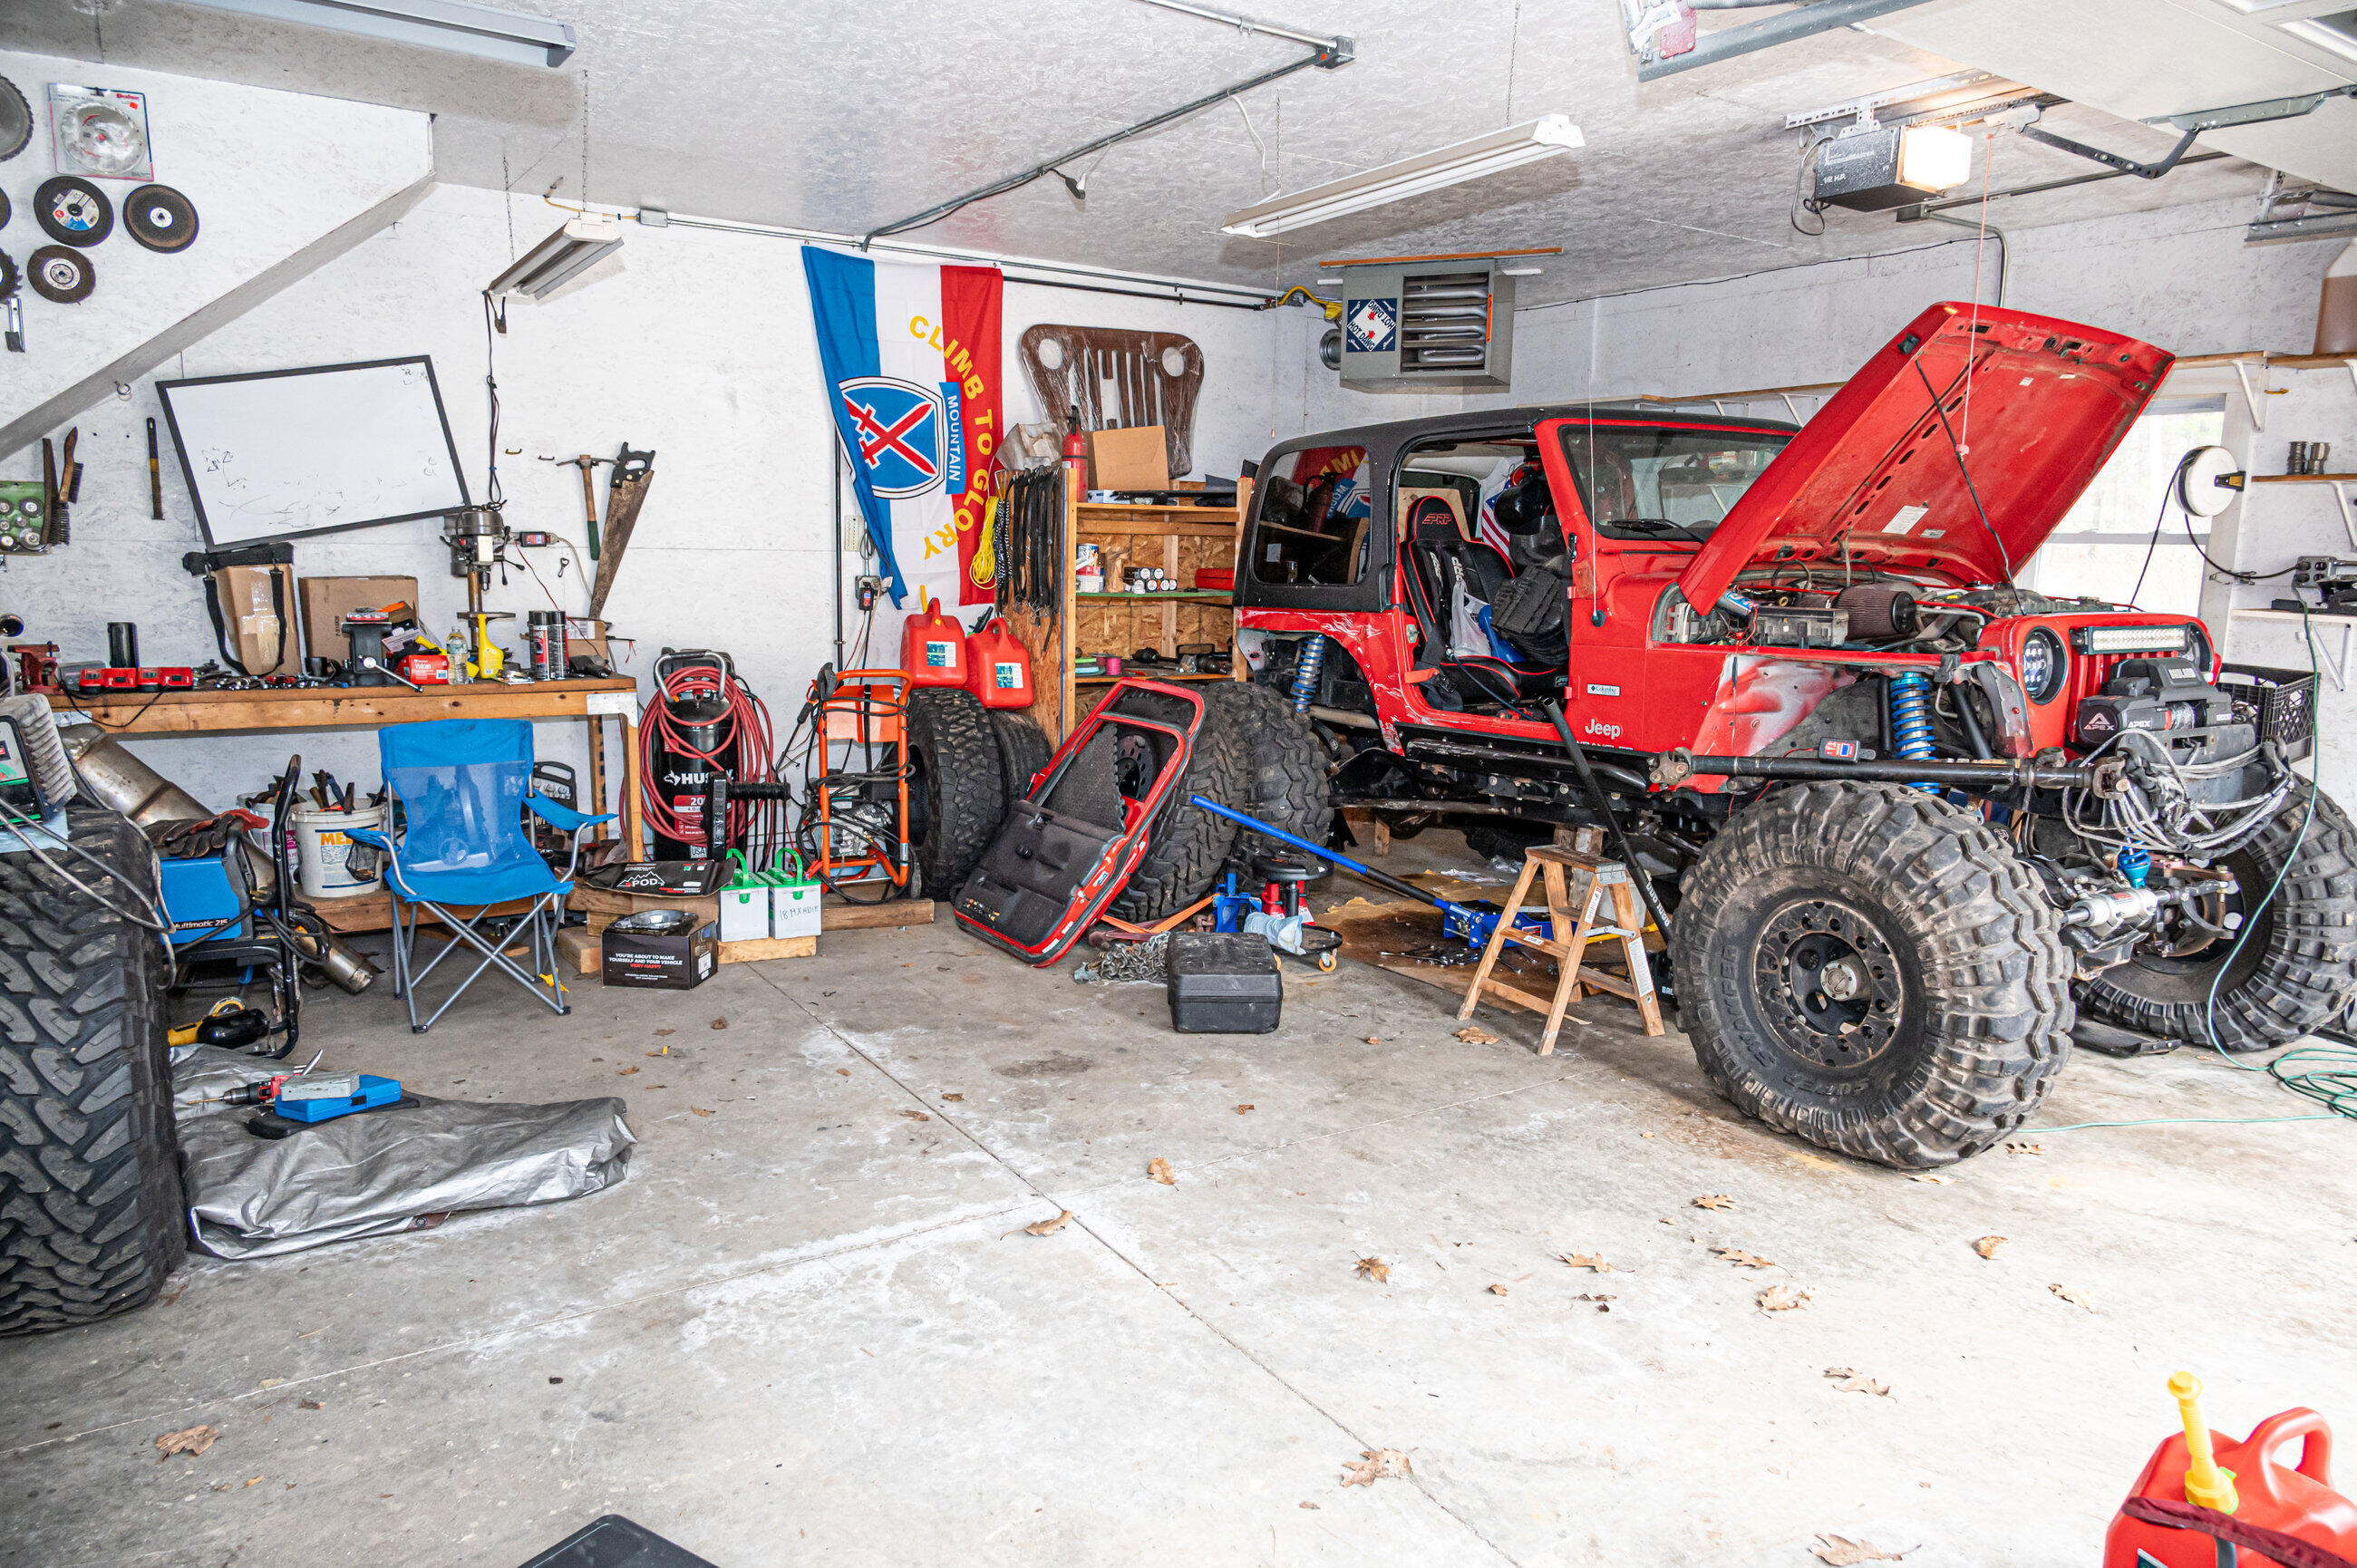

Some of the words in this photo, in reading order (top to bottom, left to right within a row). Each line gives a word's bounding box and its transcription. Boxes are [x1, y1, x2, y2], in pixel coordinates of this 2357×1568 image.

[1367, 300, 1384, 319] DAWG
[1381, 315, 1395, 330] HOT
[1348, 321, 1363, 334] HOT
[1359, 332, 1375, 351] DAWG
[909, 315, 985, 400] CLIMB
[946, 394, 961, 482] MOUNTAIN
[974, 408, 994, 456] TO
[923, 468, 989, 561] GLORY
[1421, 513, 1452, 525] PRP
[1585, 718, 1621, 740] Jeep
[2128, 721, 2151, 729] APEX
[692, 847, 705, 856] USA
[173, 920, 214, 929] Multimatic
